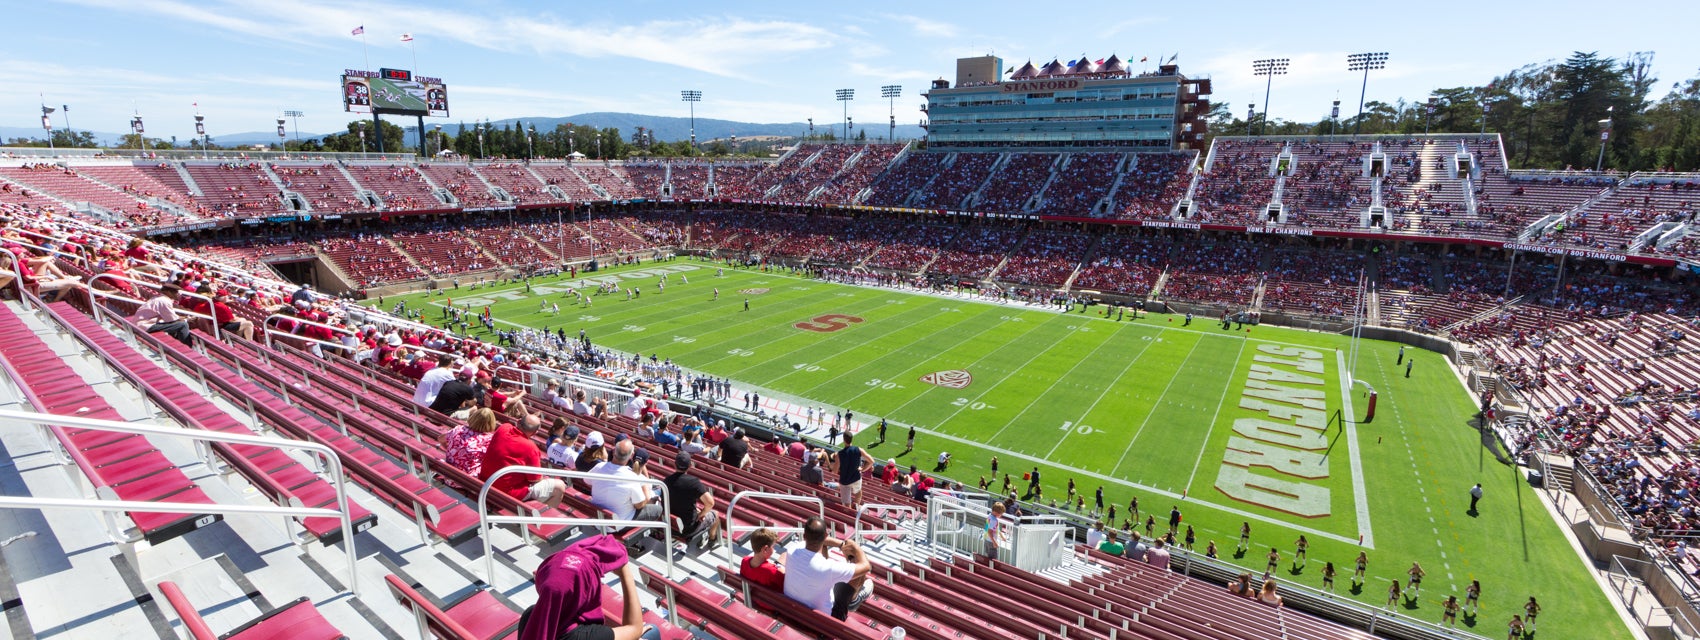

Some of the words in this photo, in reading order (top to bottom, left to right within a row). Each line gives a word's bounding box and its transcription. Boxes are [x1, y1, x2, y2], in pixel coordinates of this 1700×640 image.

[345, 69, 380, 78] STANFORD
[414, 76, 442, 84] STADIUM
[355, 86, 367, 94] 38
[1004, 80, 1078, 92] STANFORD
[1142, 220, 1169, 228] STANFORD
[1275, 228, 1313, 236] CHAMPIONS
[1503, 243, 1564, 255] GOSTANFORD.COM
[1586, 251, 1627, 262] STANFORD
[793, 363, 820, 372] 40
[865, 379, 896, 390] 30
[951, 398, 986, 410] 20
[1059, 421, 1093, 435] 10
[1214, 344, 1331, 519] STANFORD
[201, 517, 209, 525] U
